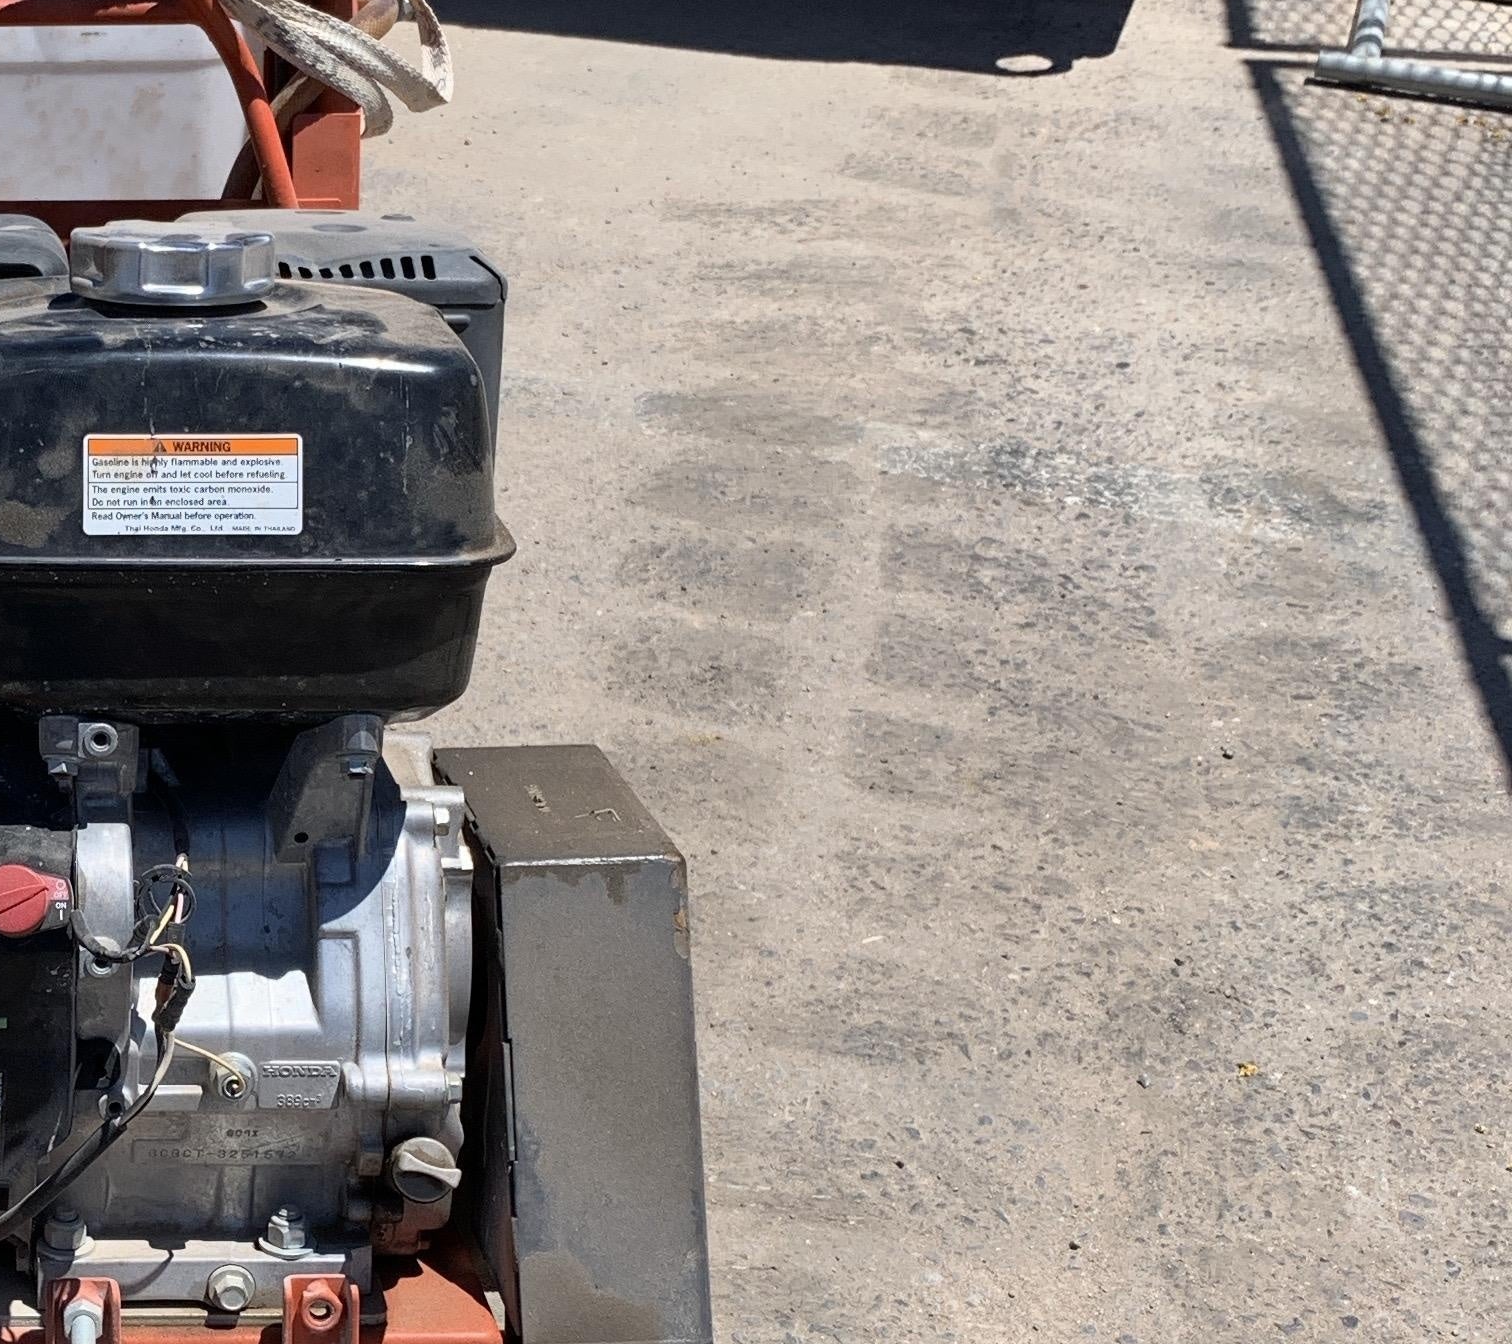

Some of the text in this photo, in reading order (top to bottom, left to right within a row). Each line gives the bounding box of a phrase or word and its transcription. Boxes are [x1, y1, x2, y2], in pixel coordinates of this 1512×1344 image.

[172, 441, 231, 452] WARNING
[92, 457, 129, 467] Gasoline
[132, 457, 140, 467] is
[171, 457, 218, 467] flammable
[221, 457, 238, 467] and
[92, 470, 111, 479] Turn
[114, 470, 143, 481] engine
[161, 470, 177, 479] and
[180, 470, 191, 479] let
[194, 470, 212, 479] cool
[215, 470, 244, 479] before
[92, 485, 108, 494] The
[110, 485, 140, 495] engine
[143, 485, 167, 494] emits
[170, 485, 191, 494] toxic
[194, 485, 225, 494] carbon
[92, 498, 103, 506] Do
[107, 498, 120, 506] not
[123, 498, 138, 506] run
[141, 498, 148, 506] in
[165, 498, 204, 506] enclosed
[92, 511, 113, 520] Read
[116, 511, 148, 520] Owner's
[151, 511, 182, 520] Manual
[184, 511, 212, 520] before
[55, 901, 67, 910] ON
[262, 1064, 338, 1078] HONDA
